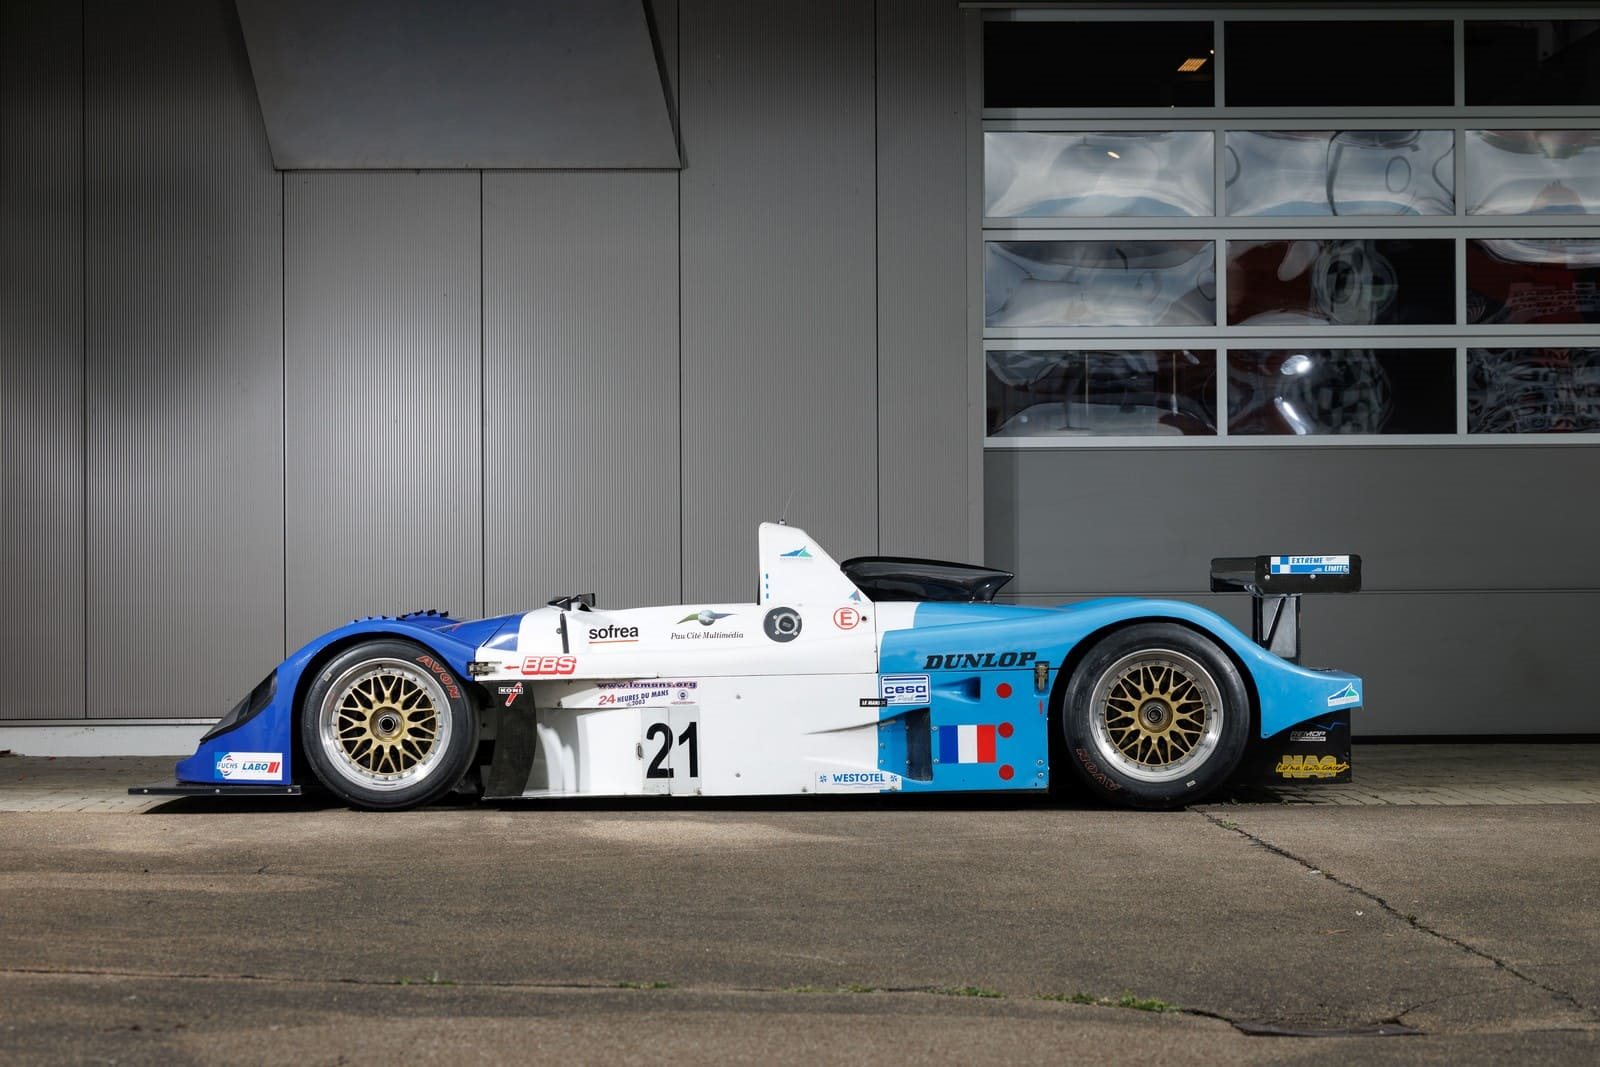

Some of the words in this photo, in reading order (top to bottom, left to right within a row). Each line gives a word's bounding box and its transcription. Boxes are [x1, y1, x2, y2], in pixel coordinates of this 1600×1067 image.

[840, 611, 853, 626] E
[588, 624, 639, 640] sofrea
[670, 632, 686, 640] Pau
[686, 631, 702, 640] Cité
[702, 631, 744, 639] Multimédia
[521, 656, 577, 675] BBS
[923, 651, 1037, 669] DUNLOP
[415, 655, 461, 699] AVON
[597, 680, 697, 689] www.lemans.org
[884, 685, 926, 694] cesa
[598, 694, 616, 706] 24
[617, 694, 640, 703] HEURES
[650, 690, 669, 698] MANS
[646, 721, 698, 779] 21
[242, 763, 268, 771] LABO
[1075, 748, 1121, 791] AVON
[832, 773, 885, 782] WESTOTEL
